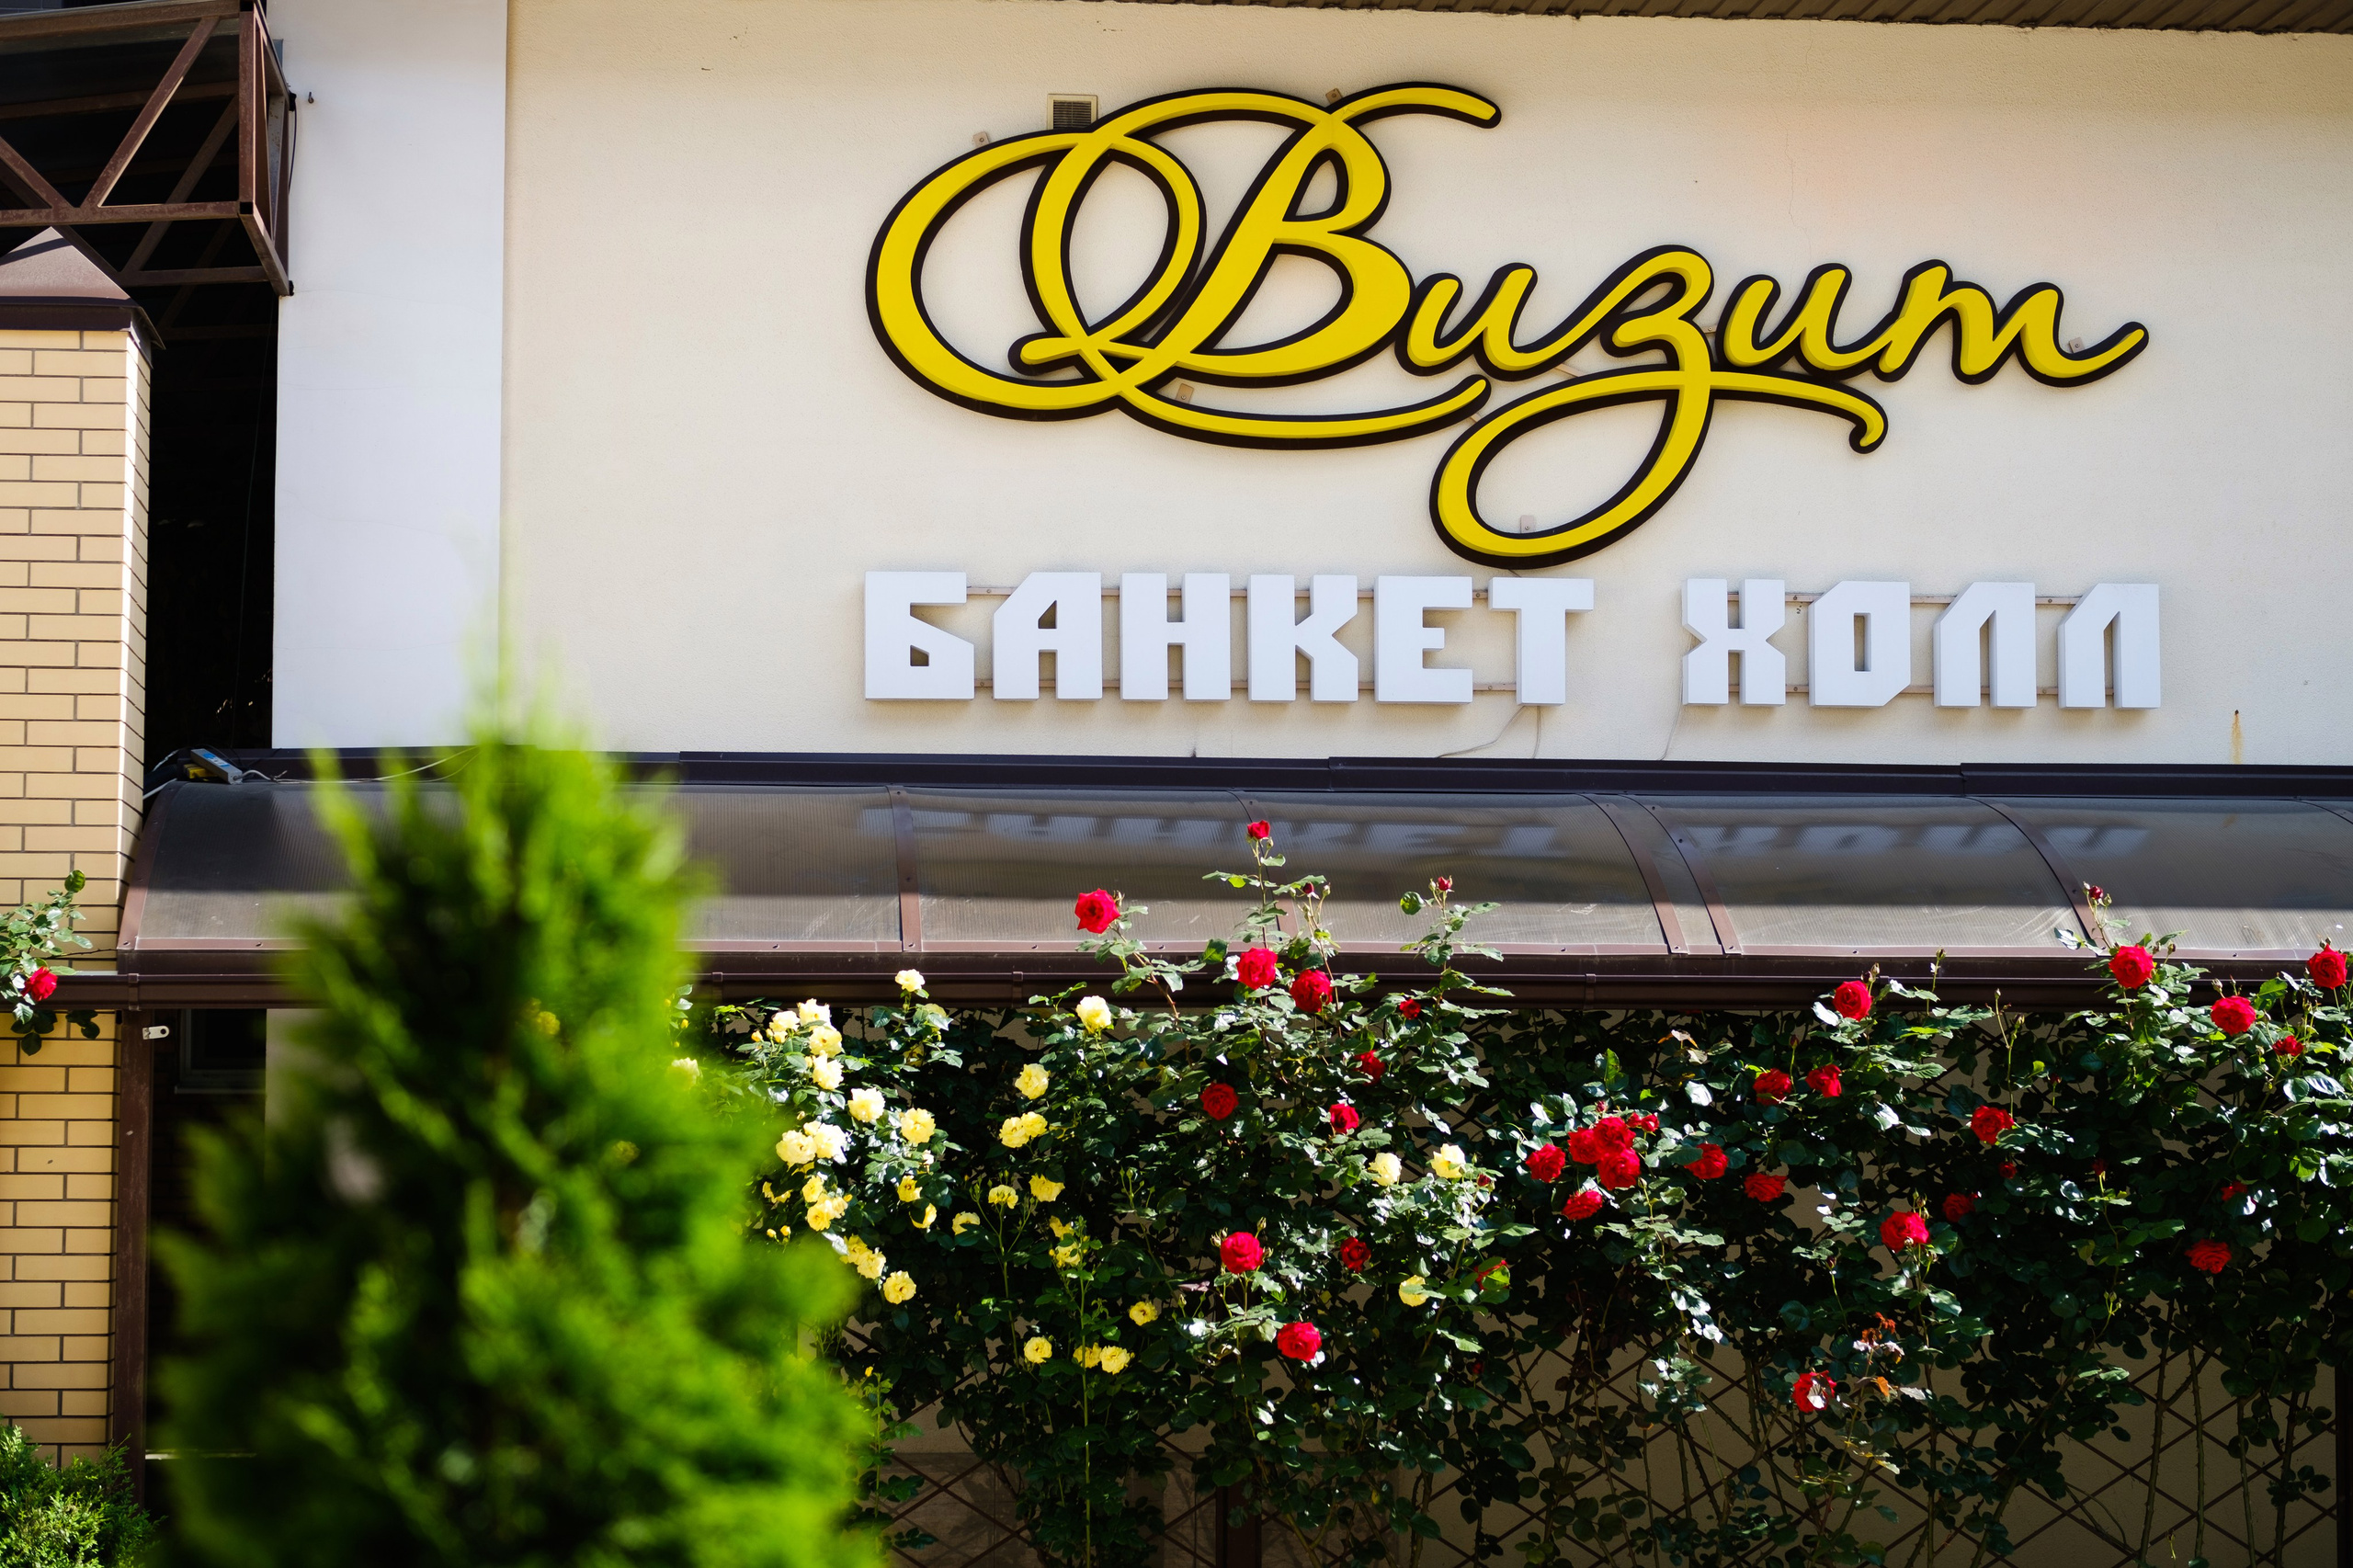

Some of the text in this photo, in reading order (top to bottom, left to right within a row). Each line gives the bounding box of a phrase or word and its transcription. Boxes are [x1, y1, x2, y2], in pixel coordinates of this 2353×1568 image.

[866, 81, 2149, 568] Визит
[865, 571, 2162, 710] БАНКЕТ ХОЛЛ
